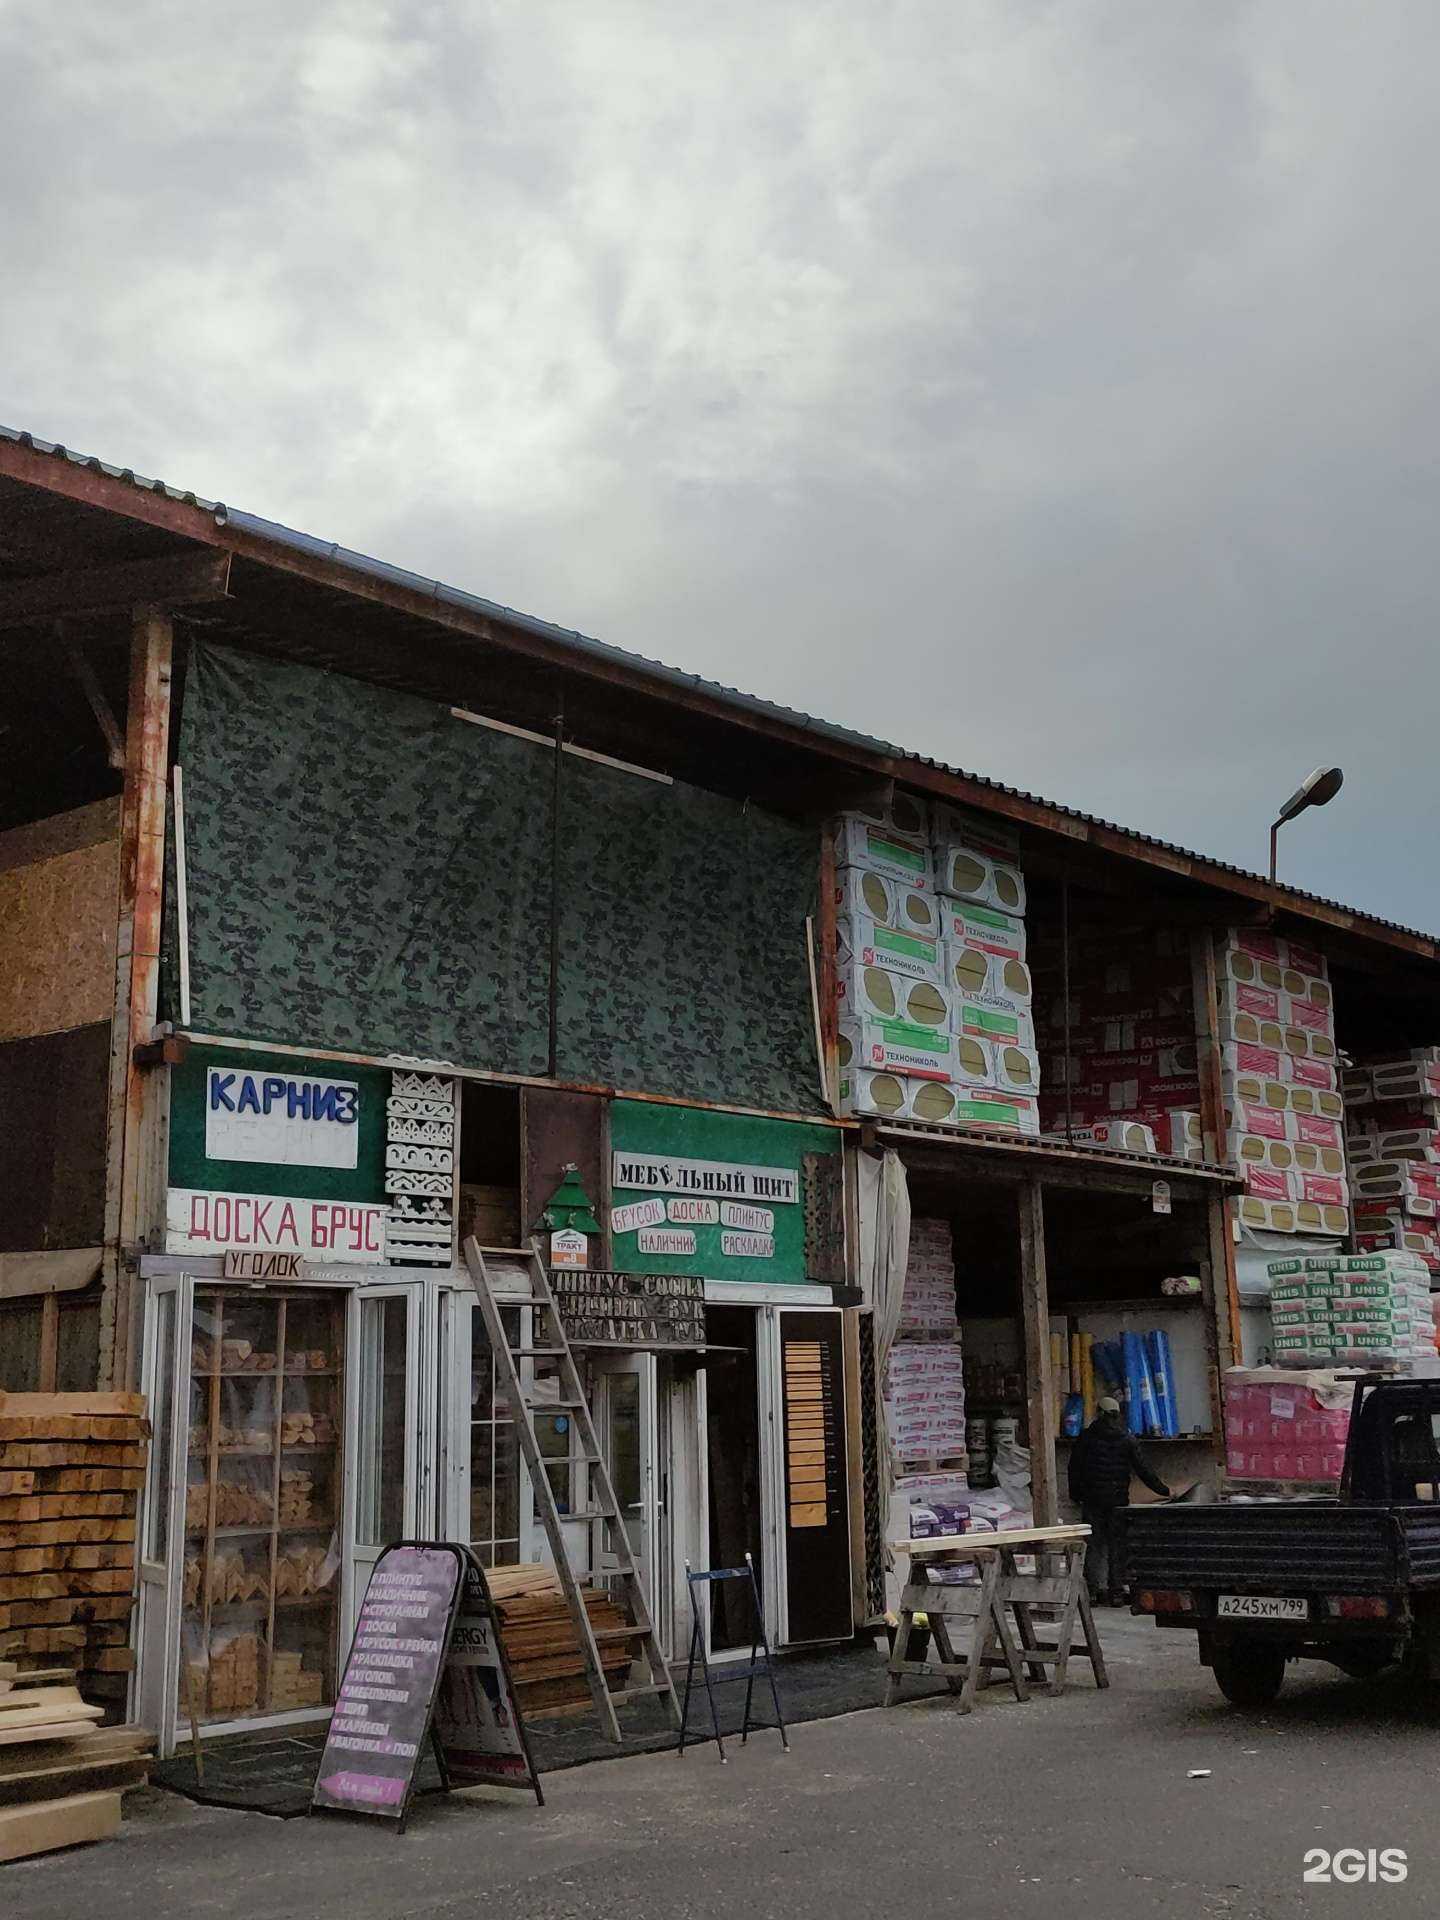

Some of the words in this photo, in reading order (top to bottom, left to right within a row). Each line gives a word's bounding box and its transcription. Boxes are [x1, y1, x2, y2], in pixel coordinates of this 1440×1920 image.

[875, 953, 926, 975] ТЕХНОНИКОЛЬ
[886, 1050, 940, 1069] ТЕХНОНИКОЛЬ
[211, 1073, 359, 1123] КАРНИЗ
[619, 1163, 746, 1193] МЕБЕЛЬНЫЙ
[752, 1175, 793, 1199] ЩИТ
[614, 1202, 660, 1230] БРУСОК
[671, 1201, 712, 1221] ДОСКА
[727, 1206, 772, 1229] ПЛИНТУС
[188, 1195, 299, 1246] ДОСКА
[311, 1204, 381, 1251] БРУС
[556, 1242, 583, 1250] ТРАКТ
[640, 1234, 696, 1253] НАЛИЧНИК
[723, 1235, 775, 1255] РАСКЛАДКА
[231, 1252, 302, 1277] УГОЛОК
[1269, 1261, 1296, 1272] UNIS
[1308, 1259, 1339, 1269] UNIS
[1351, 1260, 1383, 1269] UNIS
[1271, 1288, 1299, 1299] UNIS
[1311, 1287, 1341, 1296] UNIS
[1355, 1286, 1385, 1295] UNIS
[1272, 1313, 1300, 1323] UNIS
[1312, 1312, 1341, 1321] UNIS
[1356, 1312, 1387, 1320] UNIS
[1274, 1338, 1302, 1348] UNIS
[1314, 1336, 1344, 1346] UNIS
[1357, 1336, 1389, 1346] UNIS
[379, 1573, 423, 1586] ПЛИНТУС
[374, 1588, 428, 1602] НАЛИЧНИК
[370, 1605, 429, 1618] СТРОГАННАЯ
[366, 1620, 397, 1633] ДОСКА
[362, 1637, 398, 1650] БРУСОК
[406, 1638, 438, 1653] РЕЙКА
[360, 1653, 414, 1668] РАСКЛАДКА
[338, 1719, 390, 1736] КАРНИЗЫ
[335, 1735, 381, 1753] ВАГОНКА
